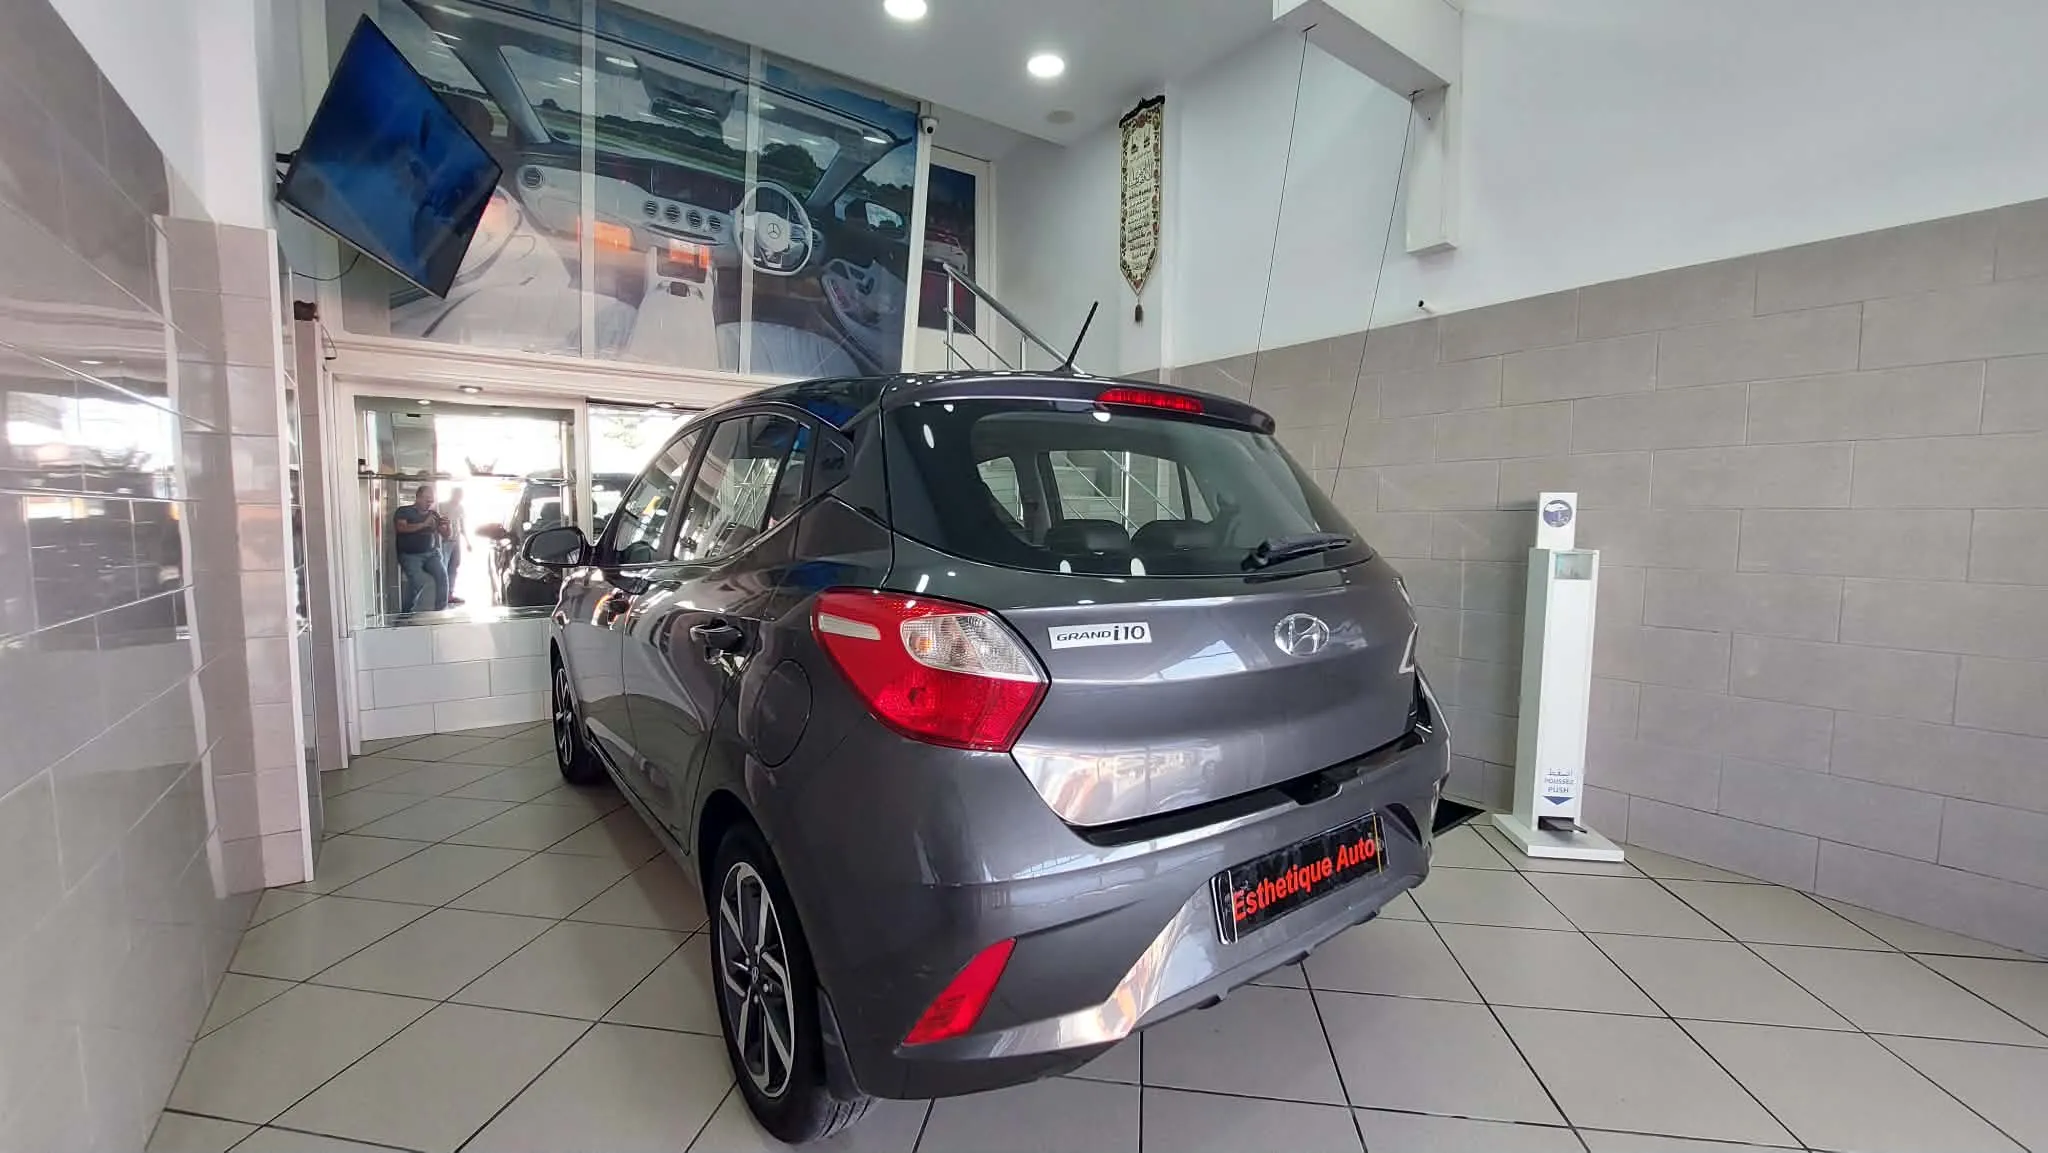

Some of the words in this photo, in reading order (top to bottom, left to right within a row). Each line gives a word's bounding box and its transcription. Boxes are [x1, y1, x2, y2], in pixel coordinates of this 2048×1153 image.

[1057, 631, 1111, 642] GRAND
[1113, 626, 1144, 641] i10
[1232, 857, 1333, 921] Esthetique
[1336, 837, 1376, 873] Auto
